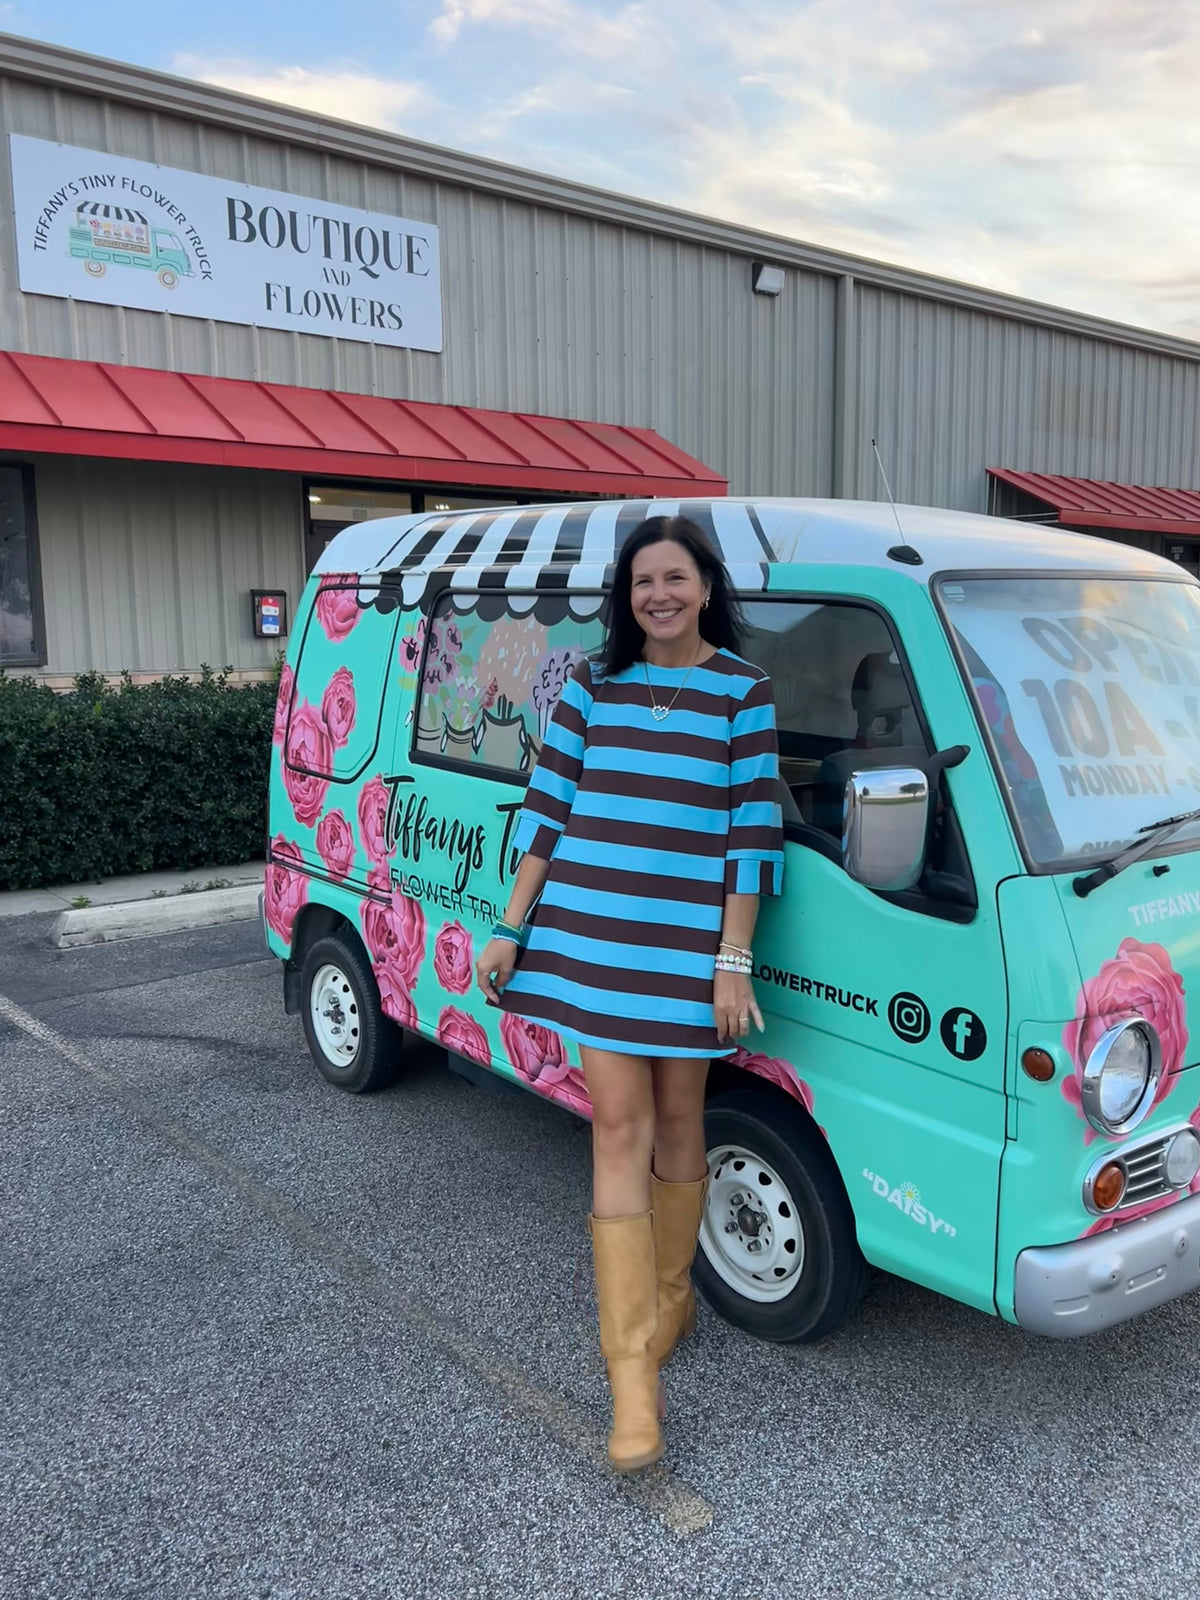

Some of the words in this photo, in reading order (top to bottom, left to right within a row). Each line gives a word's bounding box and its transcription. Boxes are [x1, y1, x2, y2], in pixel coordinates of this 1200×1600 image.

[34, 181, 79, 251] TIFFANY'S
[79, 174, 116, 190] TINY
[121, 177, 186, 226] FLOWER
[185, 225, 213, 281] TRUCK
[226, 197, 430, 279] BOUTIQUE
[320, 267, 351, 287] AND
[265, 282, 403, 330] FLOWERS
[1019, 678, 1167, 758] 10A
[1059, 764, 1171, 797] MONDAY
[383, 775, 486, 893] Tiffanys
[390, 868, 464, 914] FLOWER
[467, 894, 507, 925] TRU
[751, 961, 879, 1017] LOWERTRUCK
